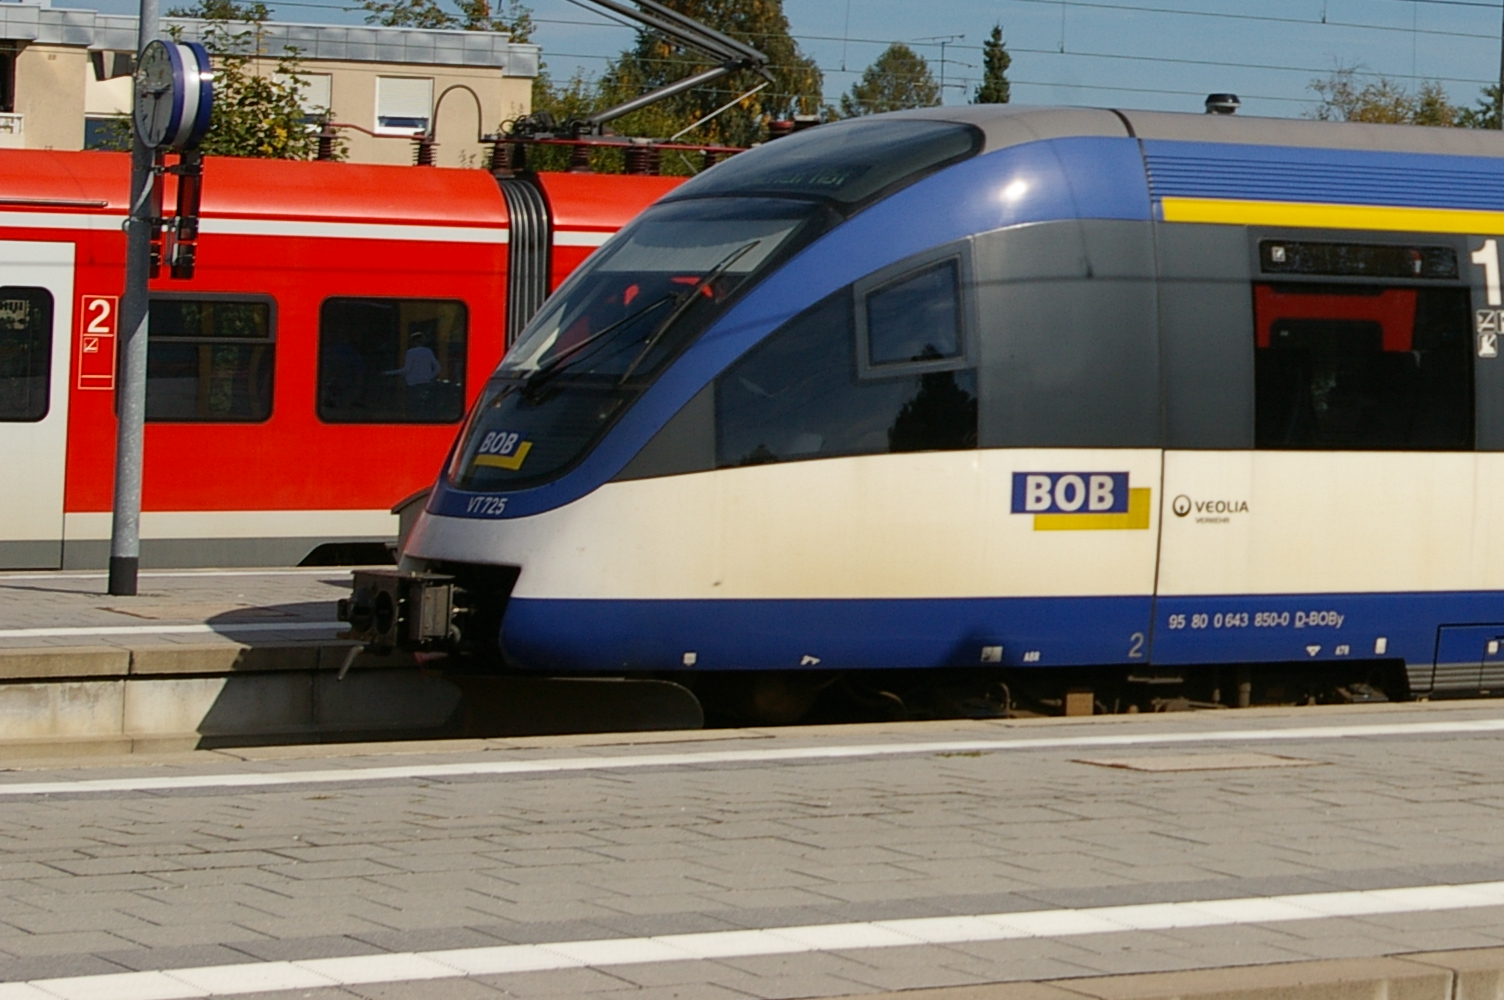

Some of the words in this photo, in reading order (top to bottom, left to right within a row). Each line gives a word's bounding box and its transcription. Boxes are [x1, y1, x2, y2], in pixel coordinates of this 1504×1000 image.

[1471, 239, 1501, 305] 1
[87, 299, 111, 333] 2
[478, 431, 519, 454] BOB
[1025, 474, 1115, 512] BOB
[1195, 501, 1249, 513] VEOLIA
[1168, 614, 1186, 629] 95
[1191, 613, 1208, 628] 80
[1254, 612, 1289, 627] 850-0
[1295, 611, 1344, 628] D-BOBy
[1128, 632, 1145, 657] 2
